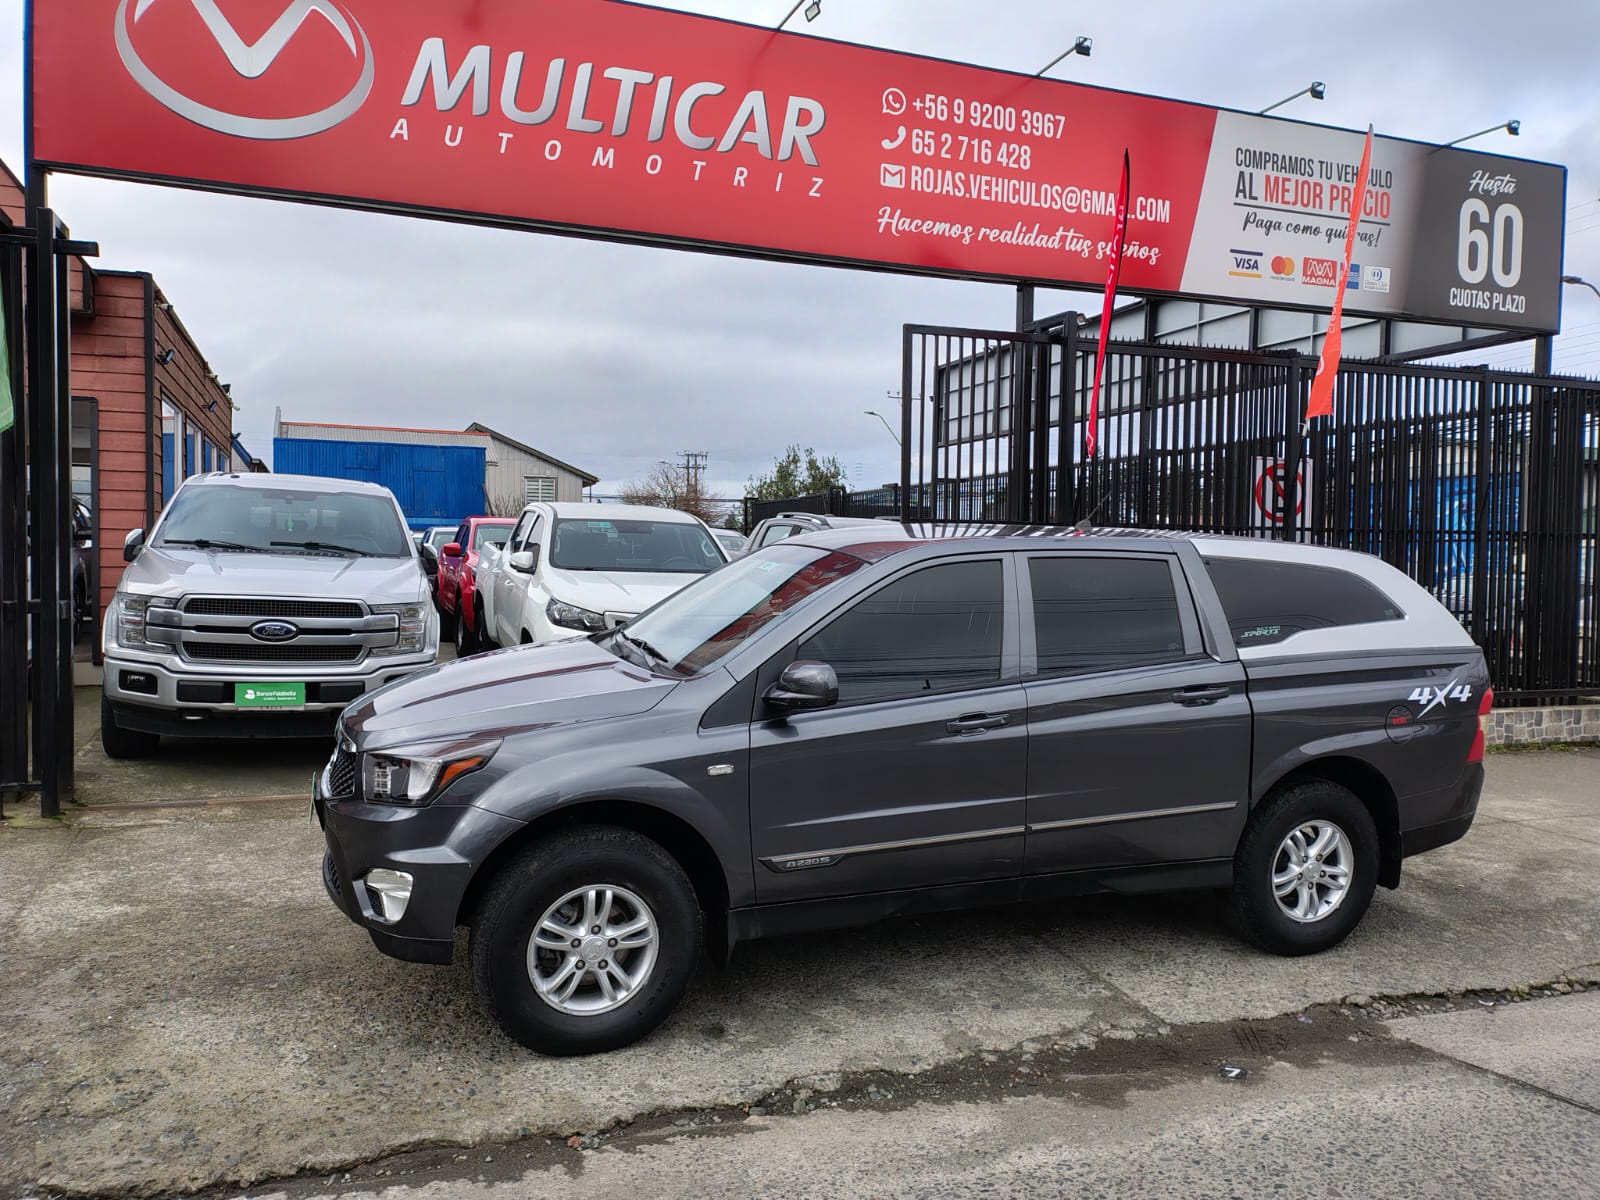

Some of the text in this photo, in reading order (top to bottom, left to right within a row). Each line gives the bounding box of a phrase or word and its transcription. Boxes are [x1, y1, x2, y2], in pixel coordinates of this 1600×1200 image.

[401, 36, 826, 167] MULTICAR
[912, 93, 1066, 139] +56 9 9200 3967
[390, 117, 825, 199] AUTOMOTRIZ
[911, 129, 1031, 171] 65 2 716 428
[1235, 147, 1393, 190] COMPRAMOS TU VEHULO
[911, 165, 1171, 224] ROJAS.VEHICULOS@GMA.COM
[1235, 170, 1391, 219] AL MEJOR PRCIO
[1469, 170, 1517, 196] Hasta
[877, 206, 975, 245] Hacemos
[977, 221, 1063, 250] realidad
[1061, 227, 1095, 258] tus
[1242, 211, 1283, 237] Paga
[1285, 222, 1323, 236] como
[1458, 198, 1524, 288] 60
[1233, 256, 1259, 271] VISA
[1302, 275, 1337, 287] MAGNA
[1450, 287, 1526, 314] CUOTAS PLAZO
